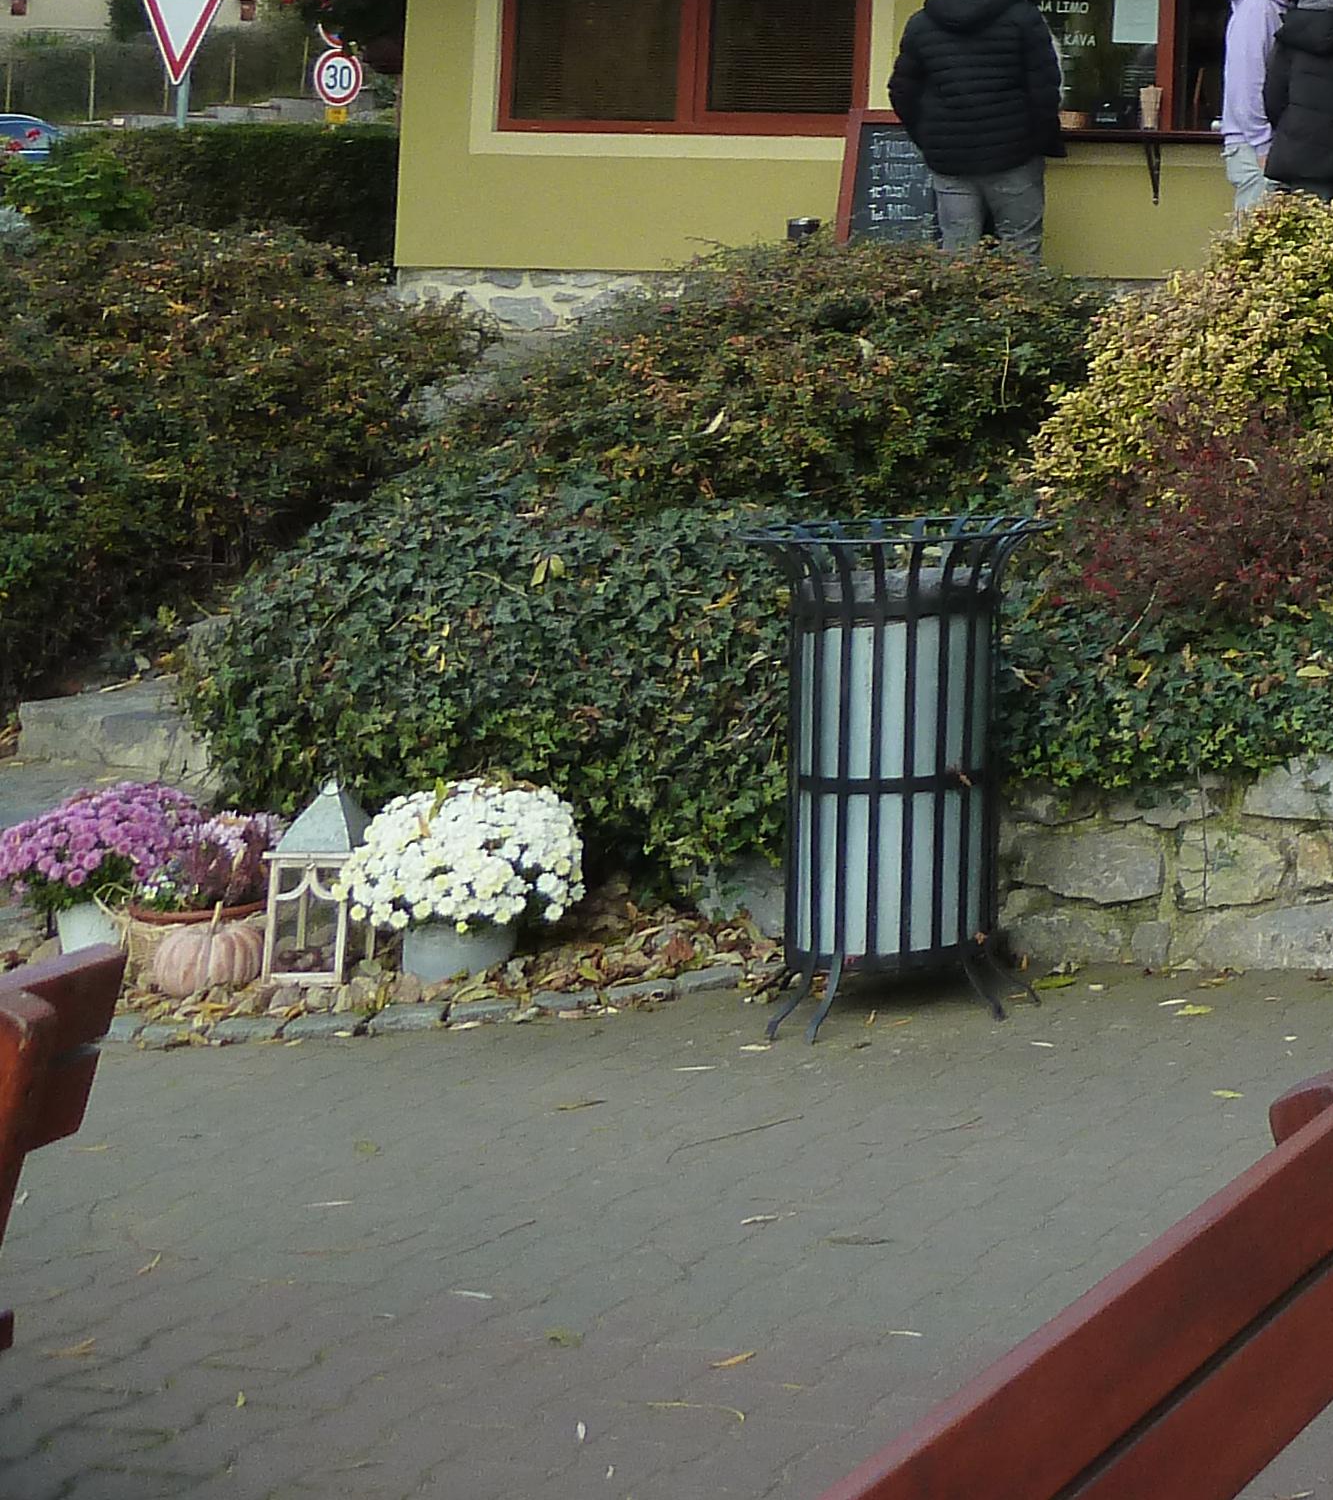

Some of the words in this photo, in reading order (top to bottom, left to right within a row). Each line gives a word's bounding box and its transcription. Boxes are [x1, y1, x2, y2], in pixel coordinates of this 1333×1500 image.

[1056, 0, 1089, 14] LIMO
[1064, 31, 1096, 46] KÁVA
[325, 65, 352, 90] 30
